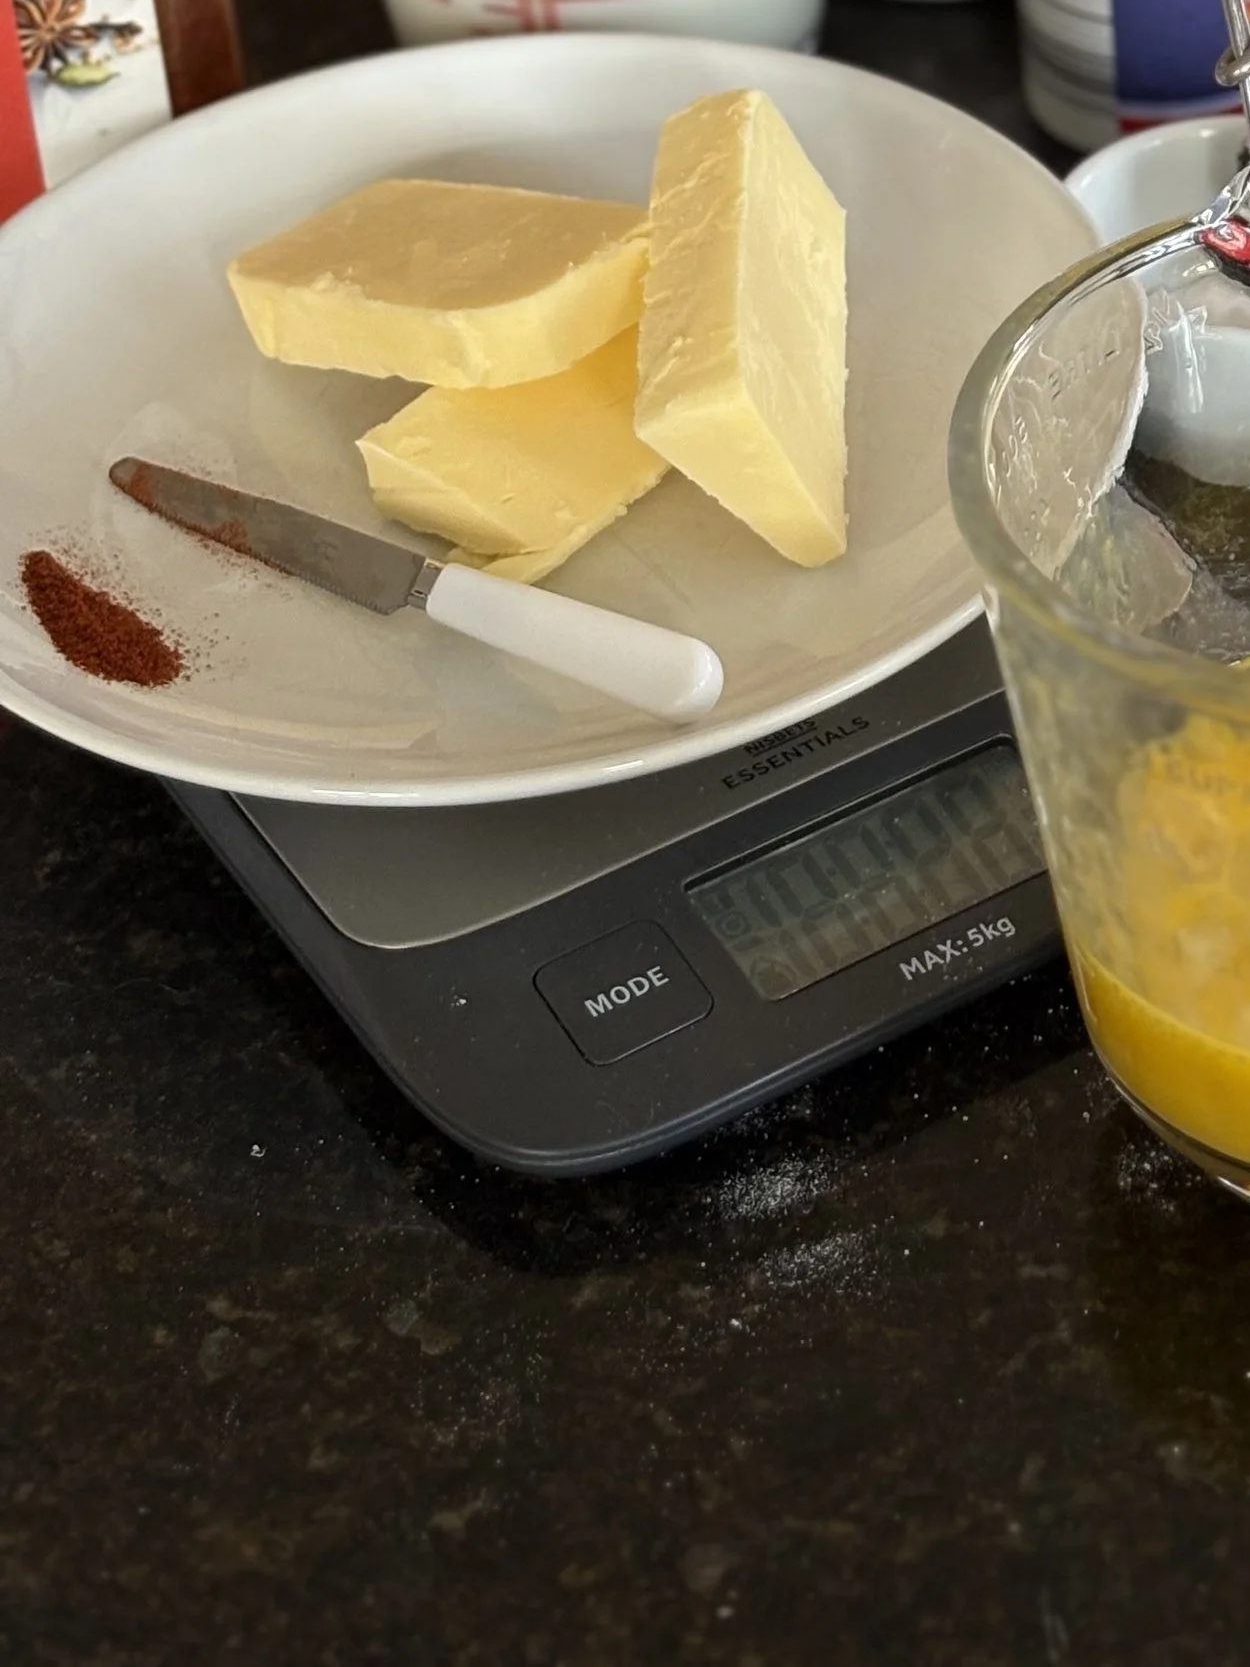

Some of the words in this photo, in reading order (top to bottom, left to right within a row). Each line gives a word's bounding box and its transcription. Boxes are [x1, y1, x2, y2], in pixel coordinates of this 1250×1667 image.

[720, 716, 871, 790] ESSENTIALS
[967, 916, 1017, 948] 5kg
[584, 965, 670, 1018] MODE
